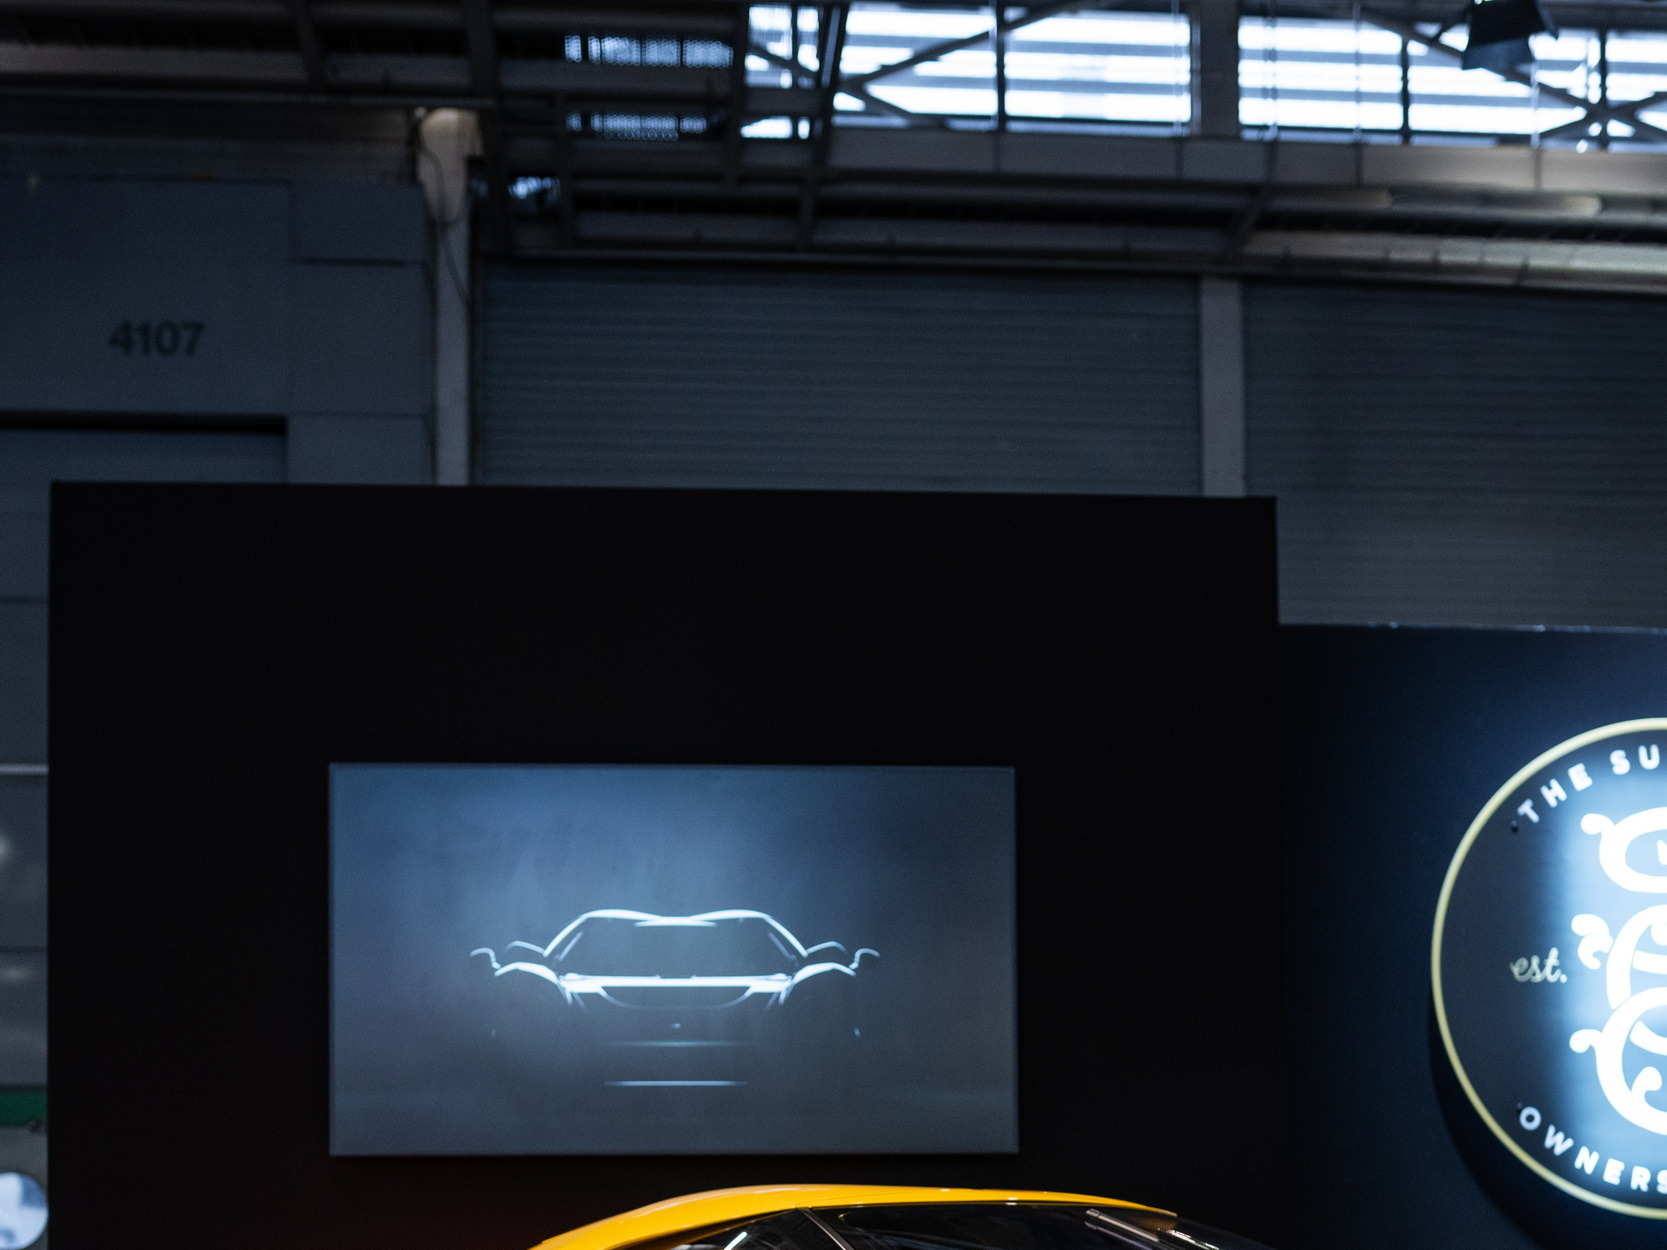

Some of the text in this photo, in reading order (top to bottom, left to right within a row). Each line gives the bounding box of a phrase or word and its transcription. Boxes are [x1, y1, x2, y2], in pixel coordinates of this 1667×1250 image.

[107, 320, 205, 355] 4107
[1517, 744, 1661, 824] THE SU
[1509, 946, 1568, 984] est.
